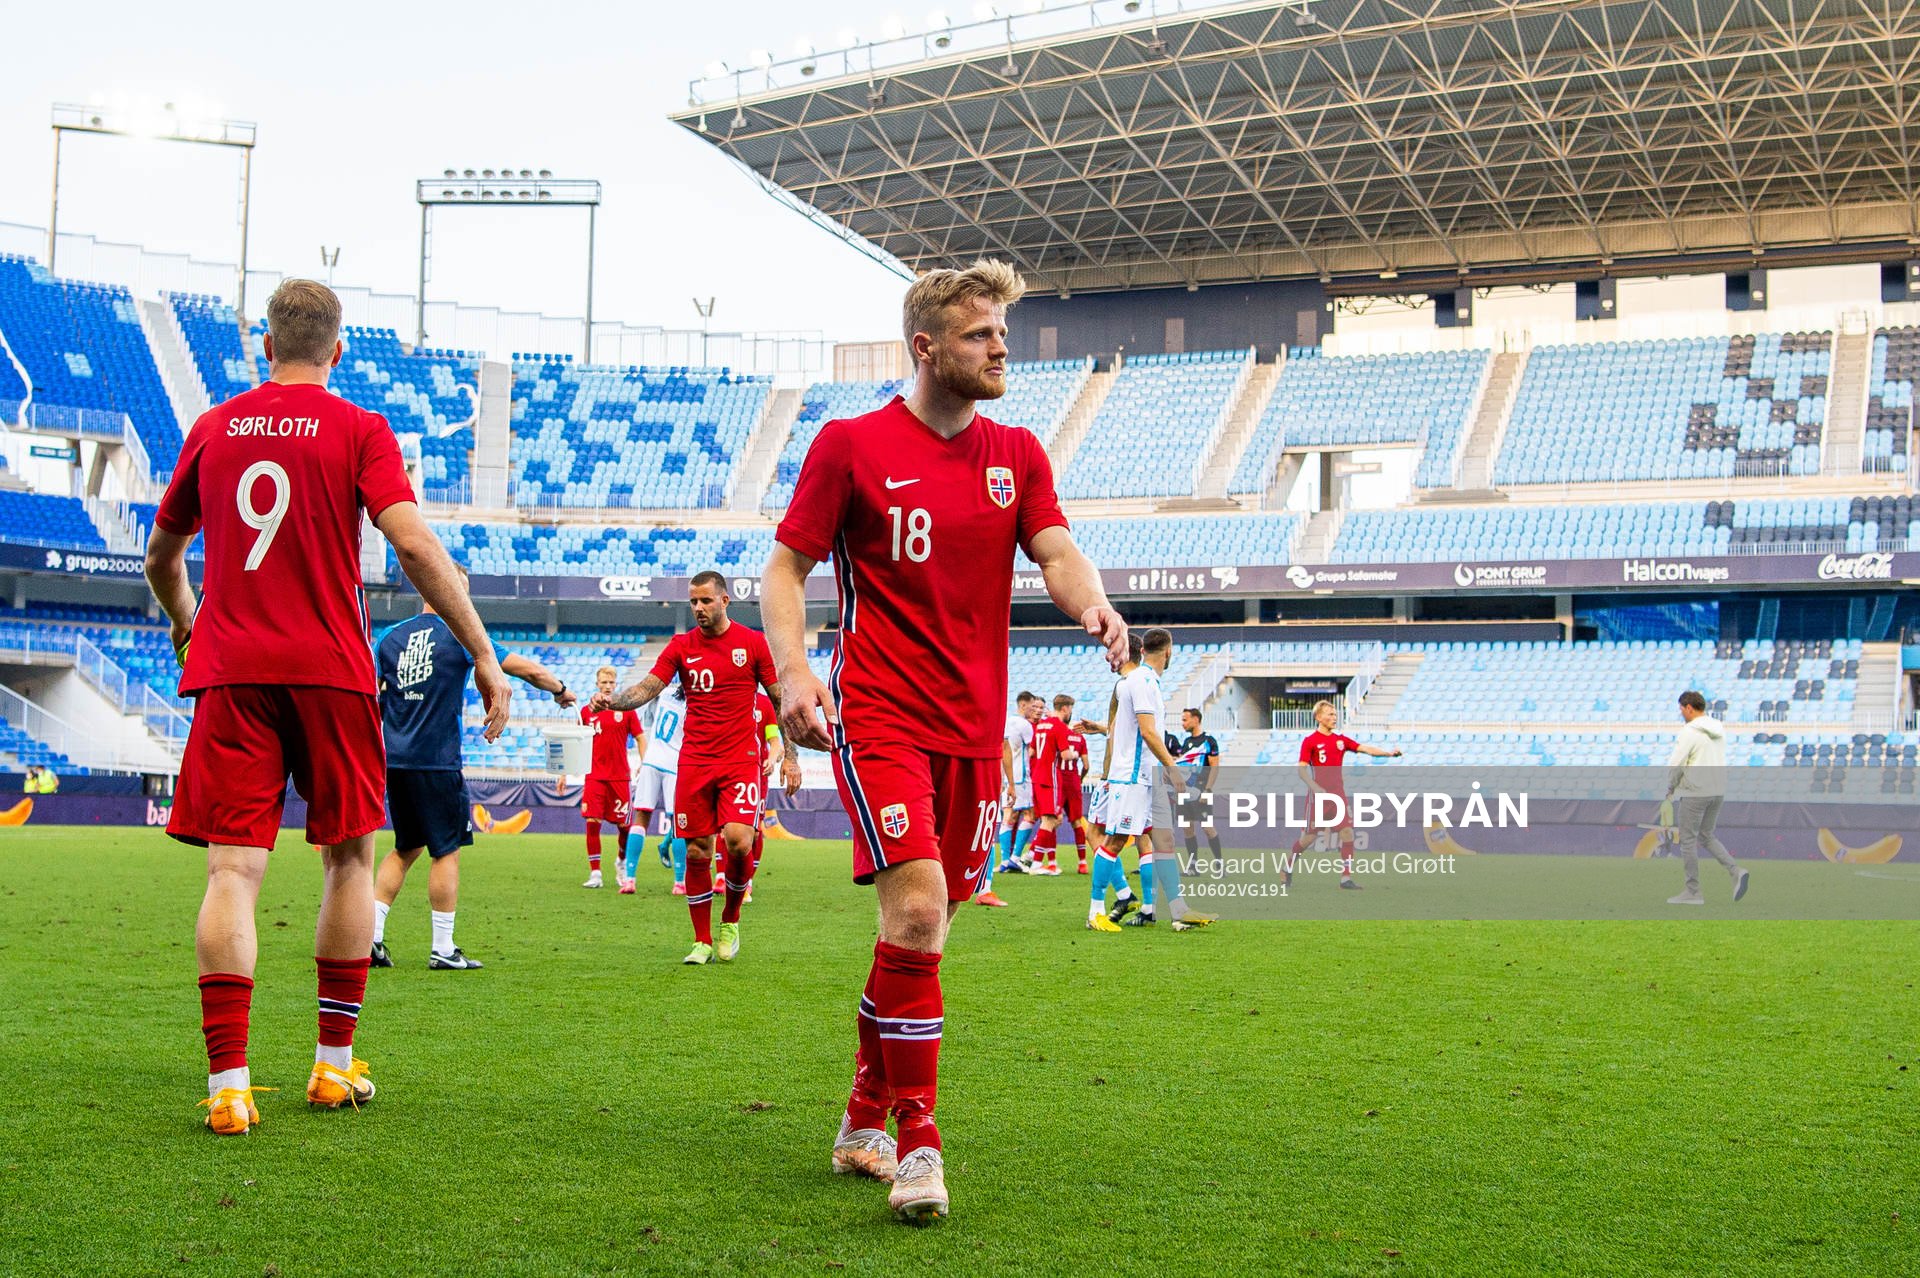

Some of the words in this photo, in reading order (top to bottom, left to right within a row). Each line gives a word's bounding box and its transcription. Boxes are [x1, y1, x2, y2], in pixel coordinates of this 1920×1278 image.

[226, 416, 320, 438] SØRLOTH
[236, 460, 291, 571] 9
[887, 506, 932, 563] 18
[66, 554, 145, 574] grupo2000
[1475, 566, 1510, 579] PONT
[1511, 566, 1547, 579] GRUP
[1315, 571, 1347, 583] Grupo
[406, 627, 434, 650] EAT
[397, 642, 436, 671] MOVE
[397, 663, 434, 690] SLEEP
[689, 668, 714, 692] 20
[733, 782, 759, 806] 20
[614, 799, 630, 815] 24
[970, 800, 998, 852] 18
